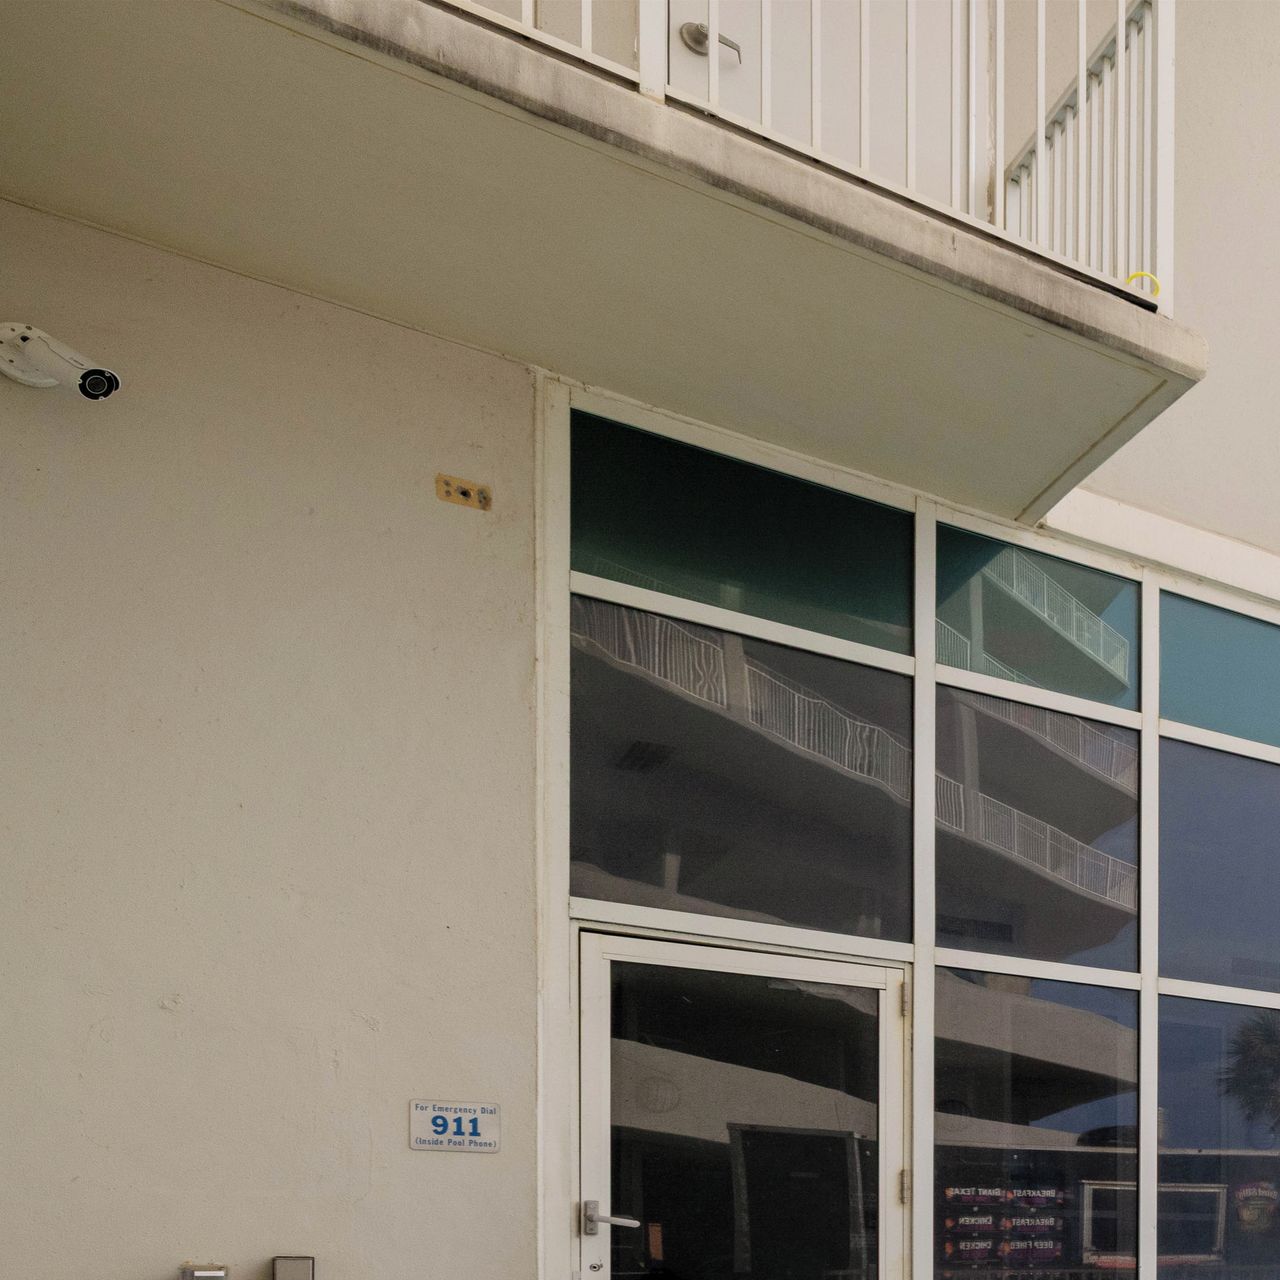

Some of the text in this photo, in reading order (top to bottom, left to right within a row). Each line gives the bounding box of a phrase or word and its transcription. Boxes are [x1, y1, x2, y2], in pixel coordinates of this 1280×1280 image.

[415, 1103, 497, 1115] For Emergency Dial
[431, 1115, 481, 1137] 911
[415, 1137, 443, 1146] (Inside
[468, 1139, 497, 1148] Phone)
